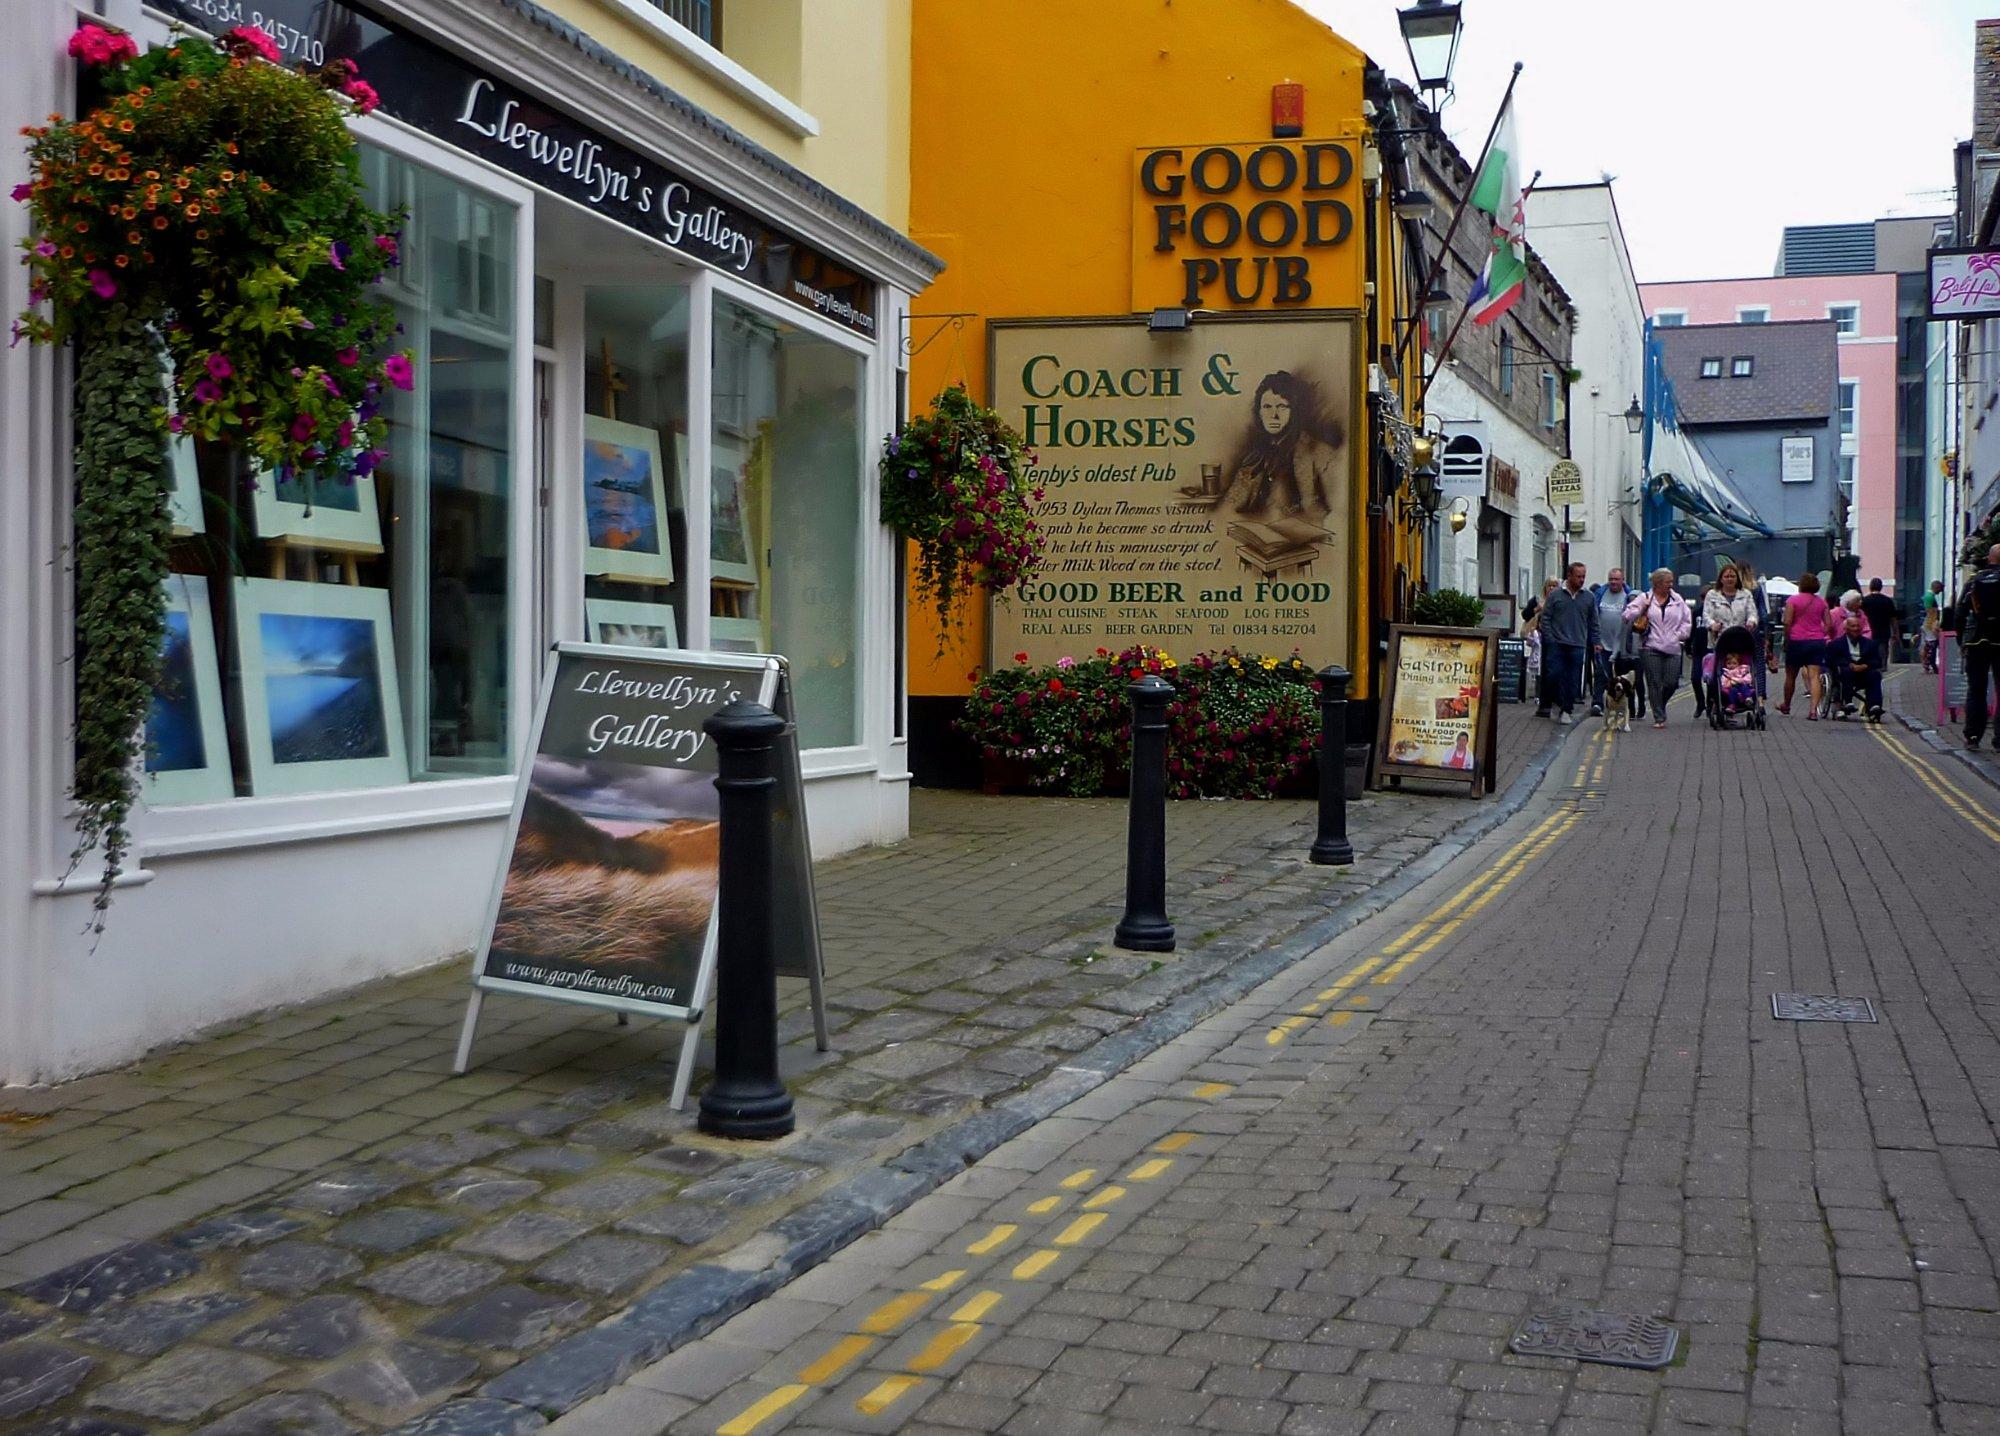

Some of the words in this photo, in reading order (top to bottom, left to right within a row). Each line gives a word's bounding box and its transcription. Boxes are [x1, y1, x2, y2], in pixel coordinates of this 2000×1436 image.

[252, 12, 324, 66] 845710
[457, 78, 653, 212] Llewellyn's
[662, 182, 753, 270] Gallery
[1141, 143, 1353, 197] GOOD
[1153, 199, 1353, 252] FOOD
[1181, 256, 1312, 305] PUB
[1021, 354, 1182, 399] COACH
[1201, 353, 1241, 396] &
[1022, 404, 1196, 448] HORSES
[1022, 464, 1080, 488] Tenby's
[1085, 463, 1137, 483] oldest
[1141, 463, 1176, 482] Pub
[1551, 484, 1582, 493] PIZZAS
[1036, 501, 1068, 517] 1953
[1072, 501, 1112, 519] Dylan
[1115, 501, 1161, 516] Thomas
[1046, 522, 1073, 537] pub
[1077, 522, 1093, 534] he
[1097, 522, 1147, 535] became
[1151, 525, 1166, 534] so
[1169, 520, 1214, 534] drunk
[1052, 541, 1066, 553] he
[1070, 540, 1092, 553] left
[1095, 540, 1115, 553] his
[1119, 539, 1198, 557] manuscript
[1202, 541, 1219, 553] of
[1061, 558, 1096, 572] Milk
[1100, 556, 1137, 572] Wood
[1139, 562, 1155, 572] on
[1159, 559, 1179, 572] the
[1018, 582, 1099, 603] GOOD
[1108, 582, 1186, 603] BEER
[1200, 585, 1242, 603] and
[1255, 582, 1331, 603] FOOD
[1022, 607, 1052, 619] THAI
[1058, 607, 1107, 619] CUISINE
[1118, 607, 1158, 619] STEAK
[1175, 608, 1229, 619] SEAFOOD
[1245, 608, 1269, 619] LOG
[1275, 608, 1309, 619] FIRES
[1022, 624, 1055, 635] REAL
[1060, 624, 1092, 635] ALES
[1106, 624, 1135, 635] BEER
[1141, 624, 1193, 635] GARDEN
[1208, 624, 1225, 635] Tel
[1233, 624, 1267, 635] 01834
[1272, 624, 1316, 635] 842704
[574, 669, 742, 709] Llewellyn's
[1401, 671, 1434, 684] Dining
[588, 714, 707, 763] Gallery
[505, 962, 676, 999] www.garyllewellyn.com
